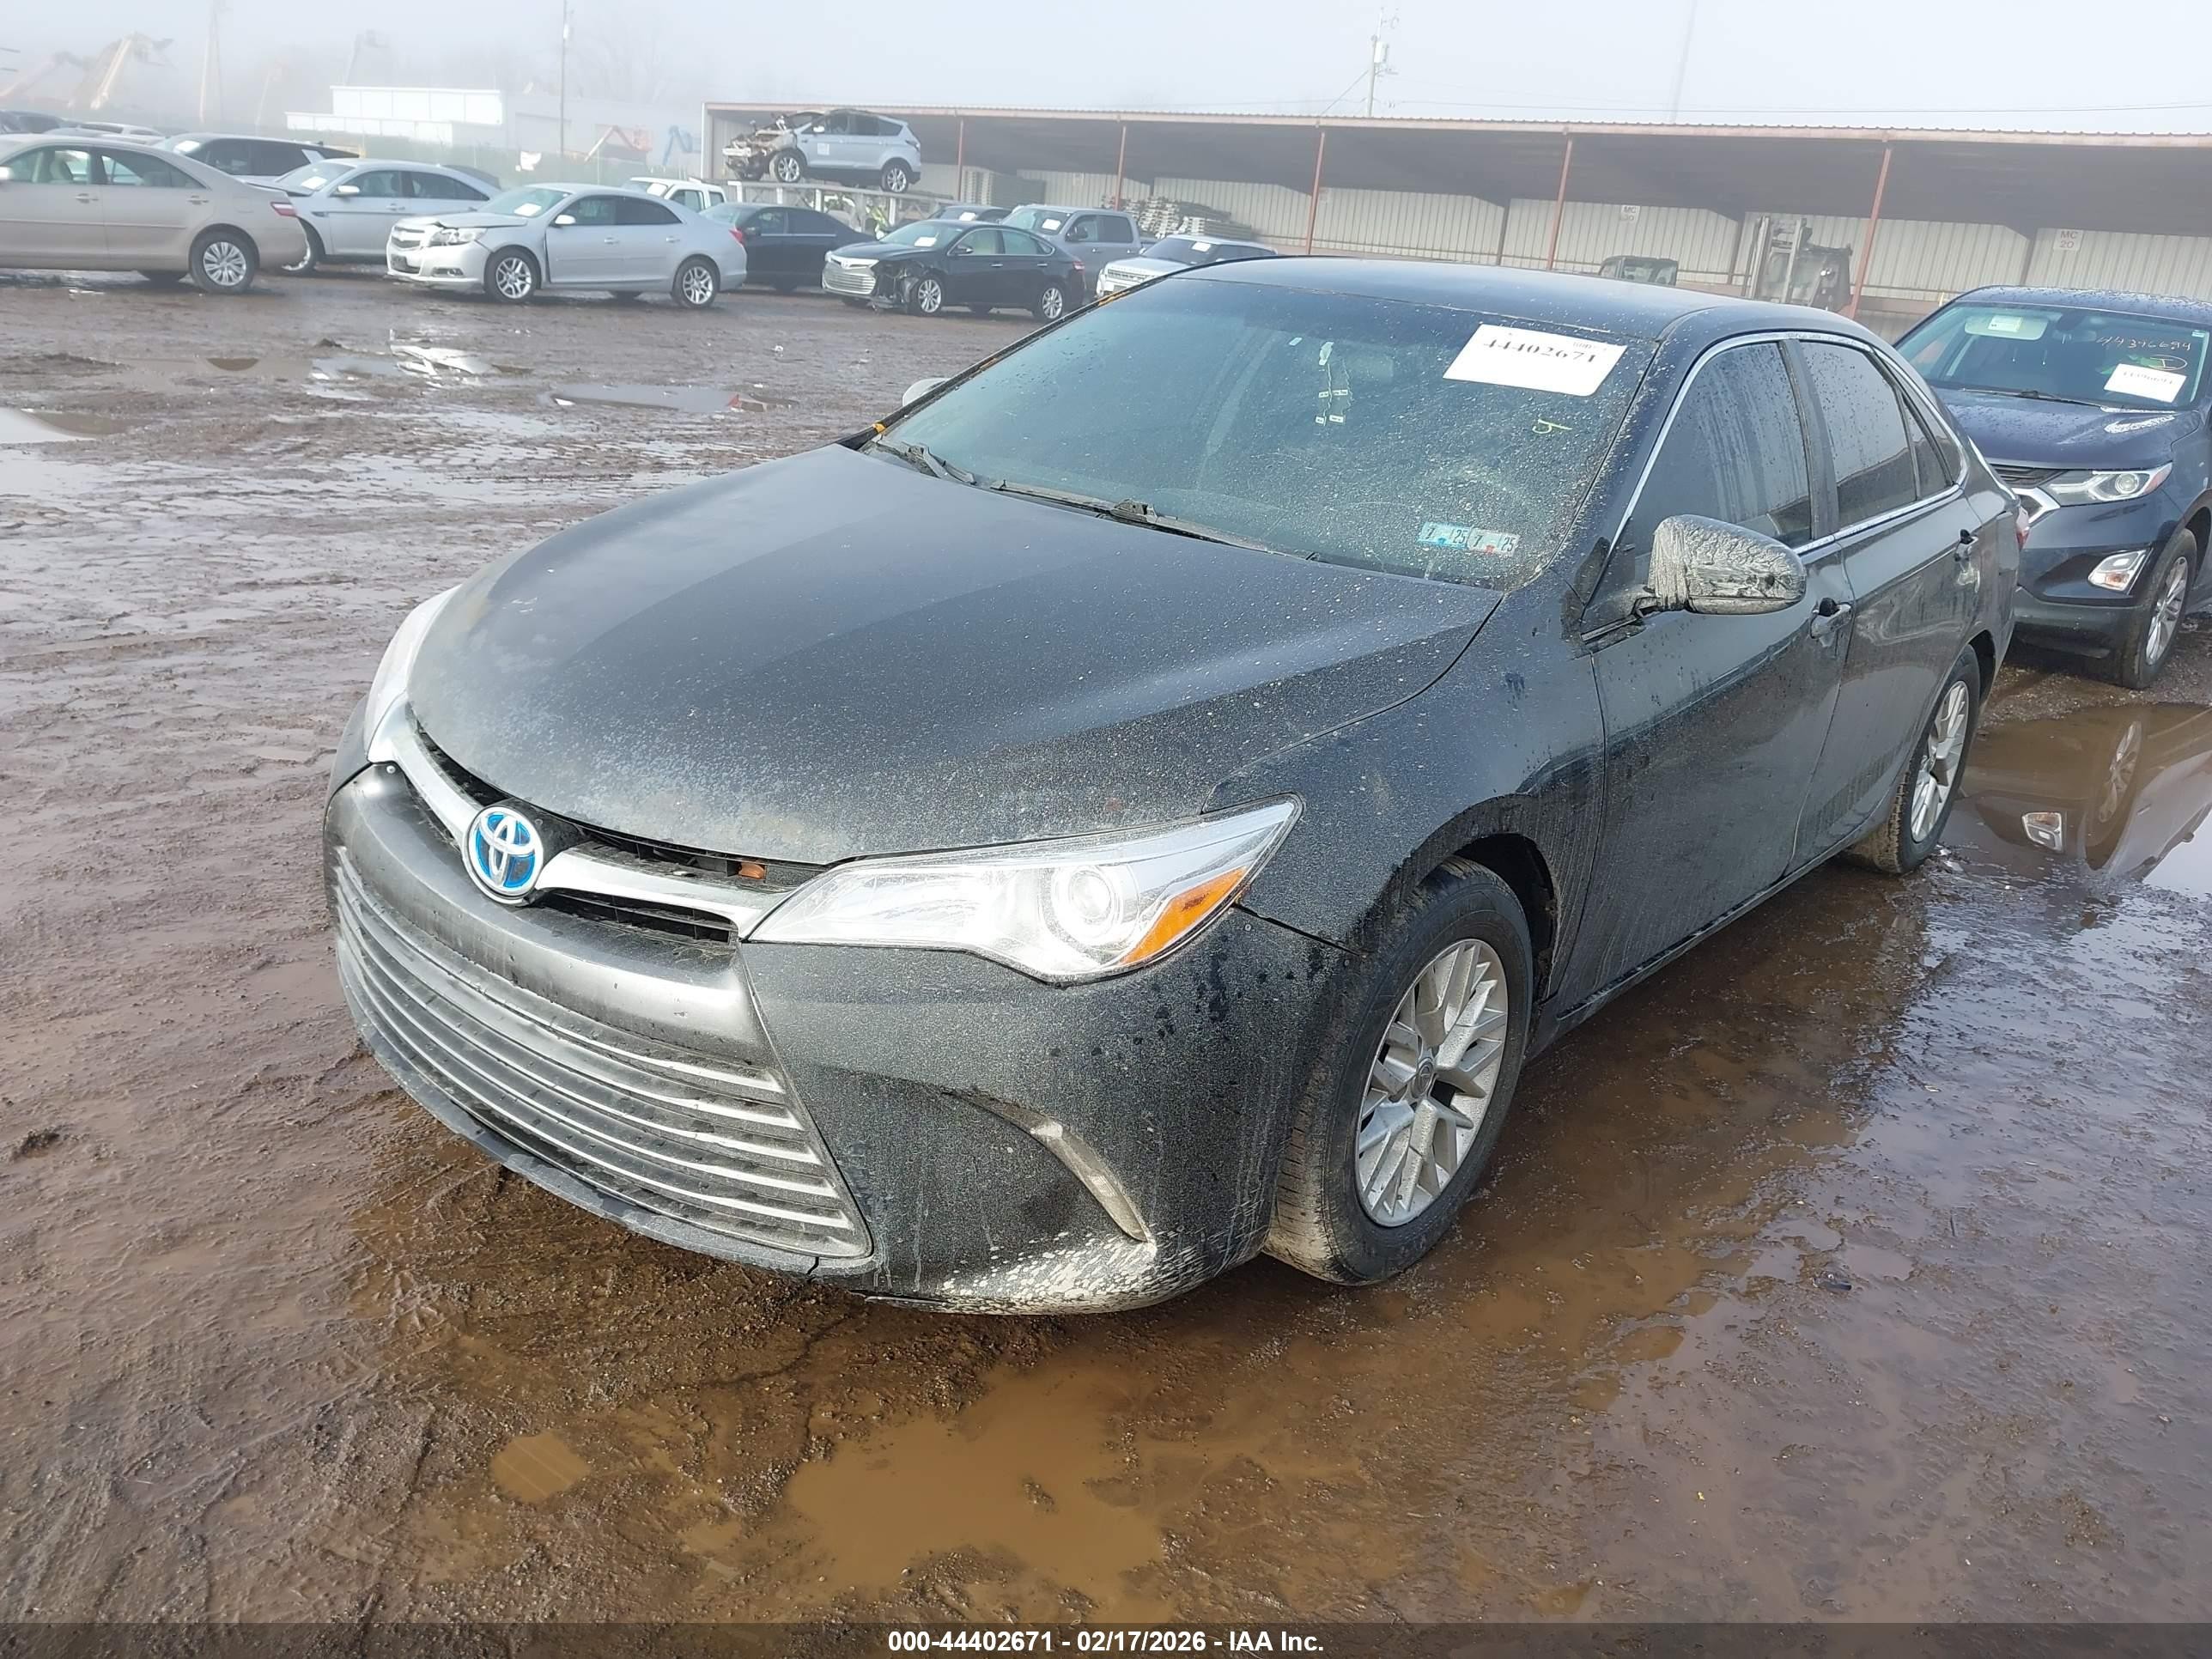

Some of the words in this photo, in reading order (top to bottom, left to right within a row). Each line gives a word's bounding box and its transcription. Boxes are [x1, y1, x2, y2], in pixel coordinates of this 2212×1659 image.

[2060, 230, 2078, 240] MC
[2060, 240, 2075, 249] 20
[1483, 338, 1597, 363] 44402671
[1425, 527, 1436, 540] 7
[1452, 529, 1468, 544] 25
[1473, 534, 1484, 548] 7
[1501, 537, 1516, 552] 25
